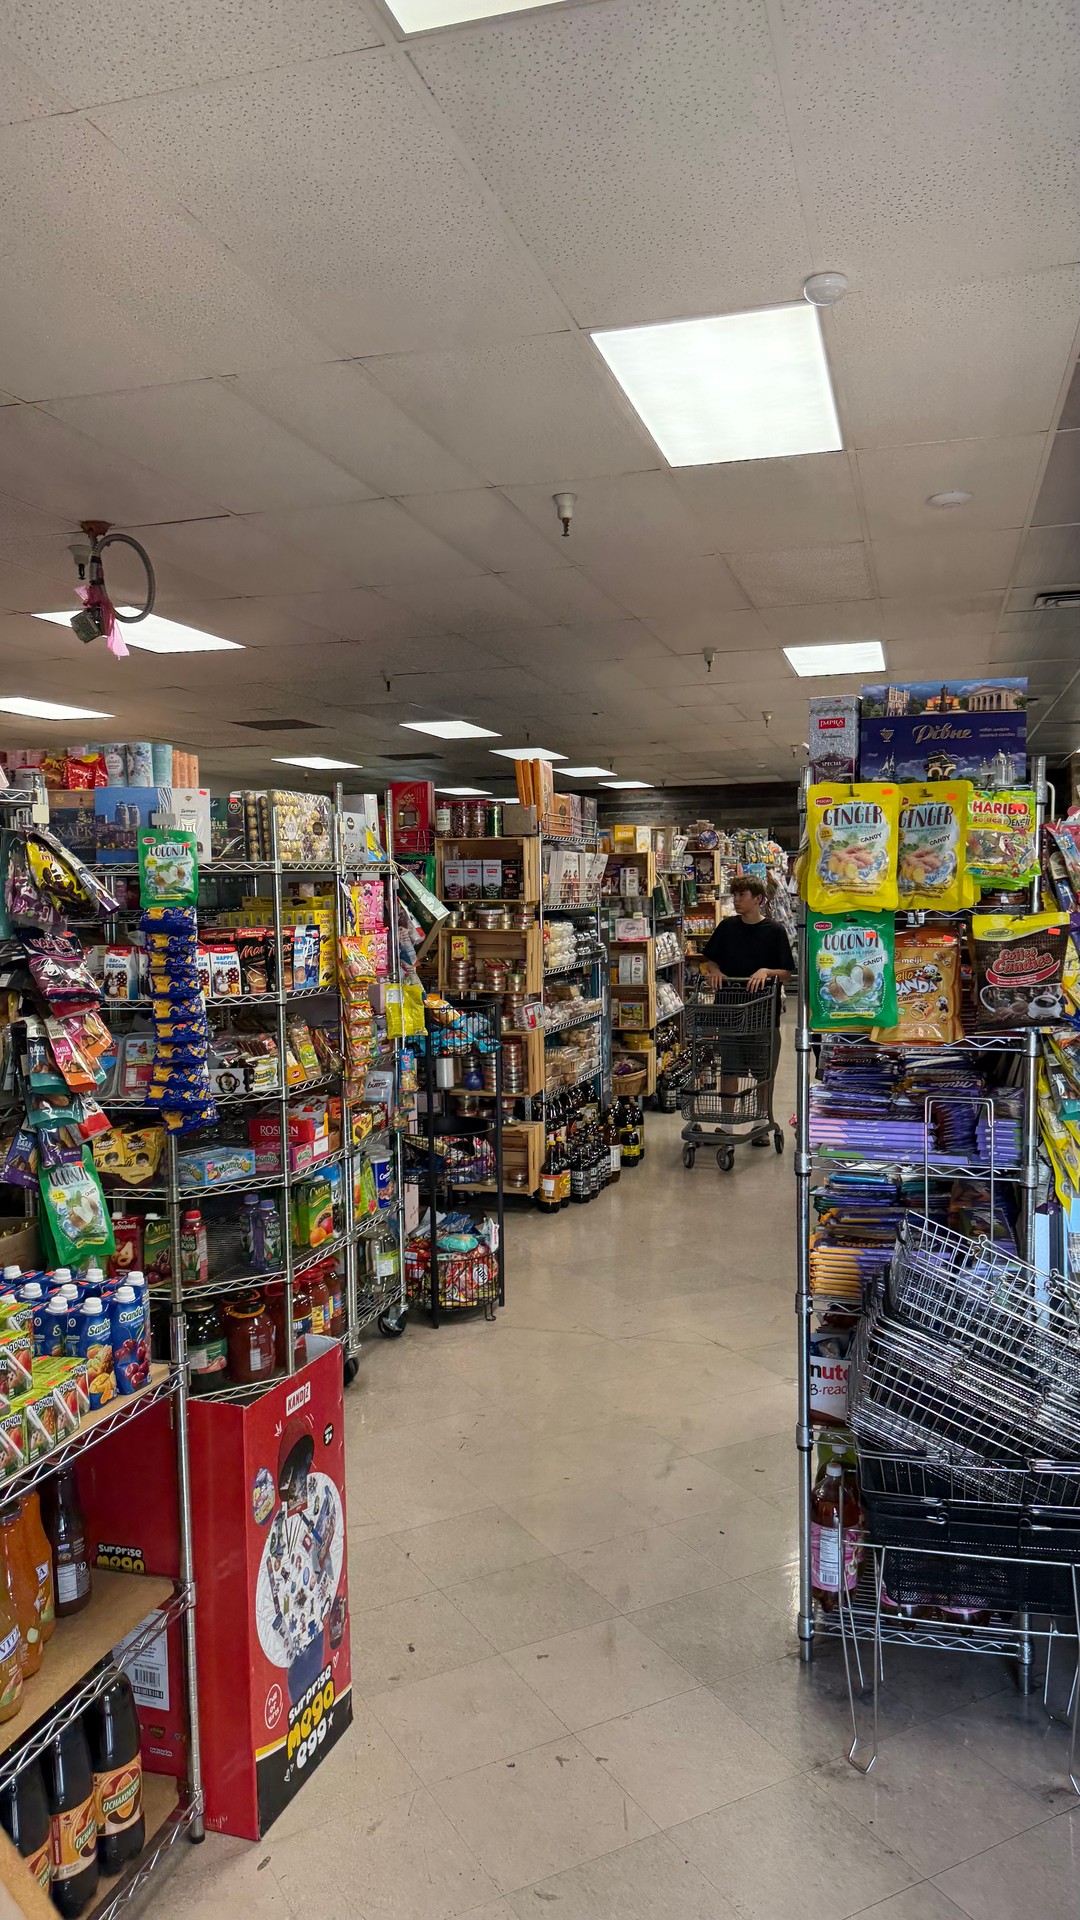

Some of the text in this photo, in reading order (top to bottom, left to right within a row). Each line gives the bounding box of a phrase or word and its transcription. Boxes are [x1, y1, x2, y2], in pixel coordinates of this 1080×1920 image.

[912, 722, 973, 744] Рівне
[972, 801, 1028, 815] HARIBO
[822, 806, 883, 826] GINGER
[899, 806, 954, 828] GINGER
[860, 833, 882, 842] CANDY
[929, 834, 951, 845] CANDY
[823, 932, 879, 951] COCONUT
[1000, 948, 1038, 960] Coffee
[863, 957, 883, 966] CANDY
[993, 953, 1053, 973] Candies
[896, 970, 913, 981] ello
[898, 994, 924, 1002] Caramel
[367, 1080, 387, 1090] bueno
[181, 1241, 196, 1250] King
[296, 1716, 327, 1769] egg
